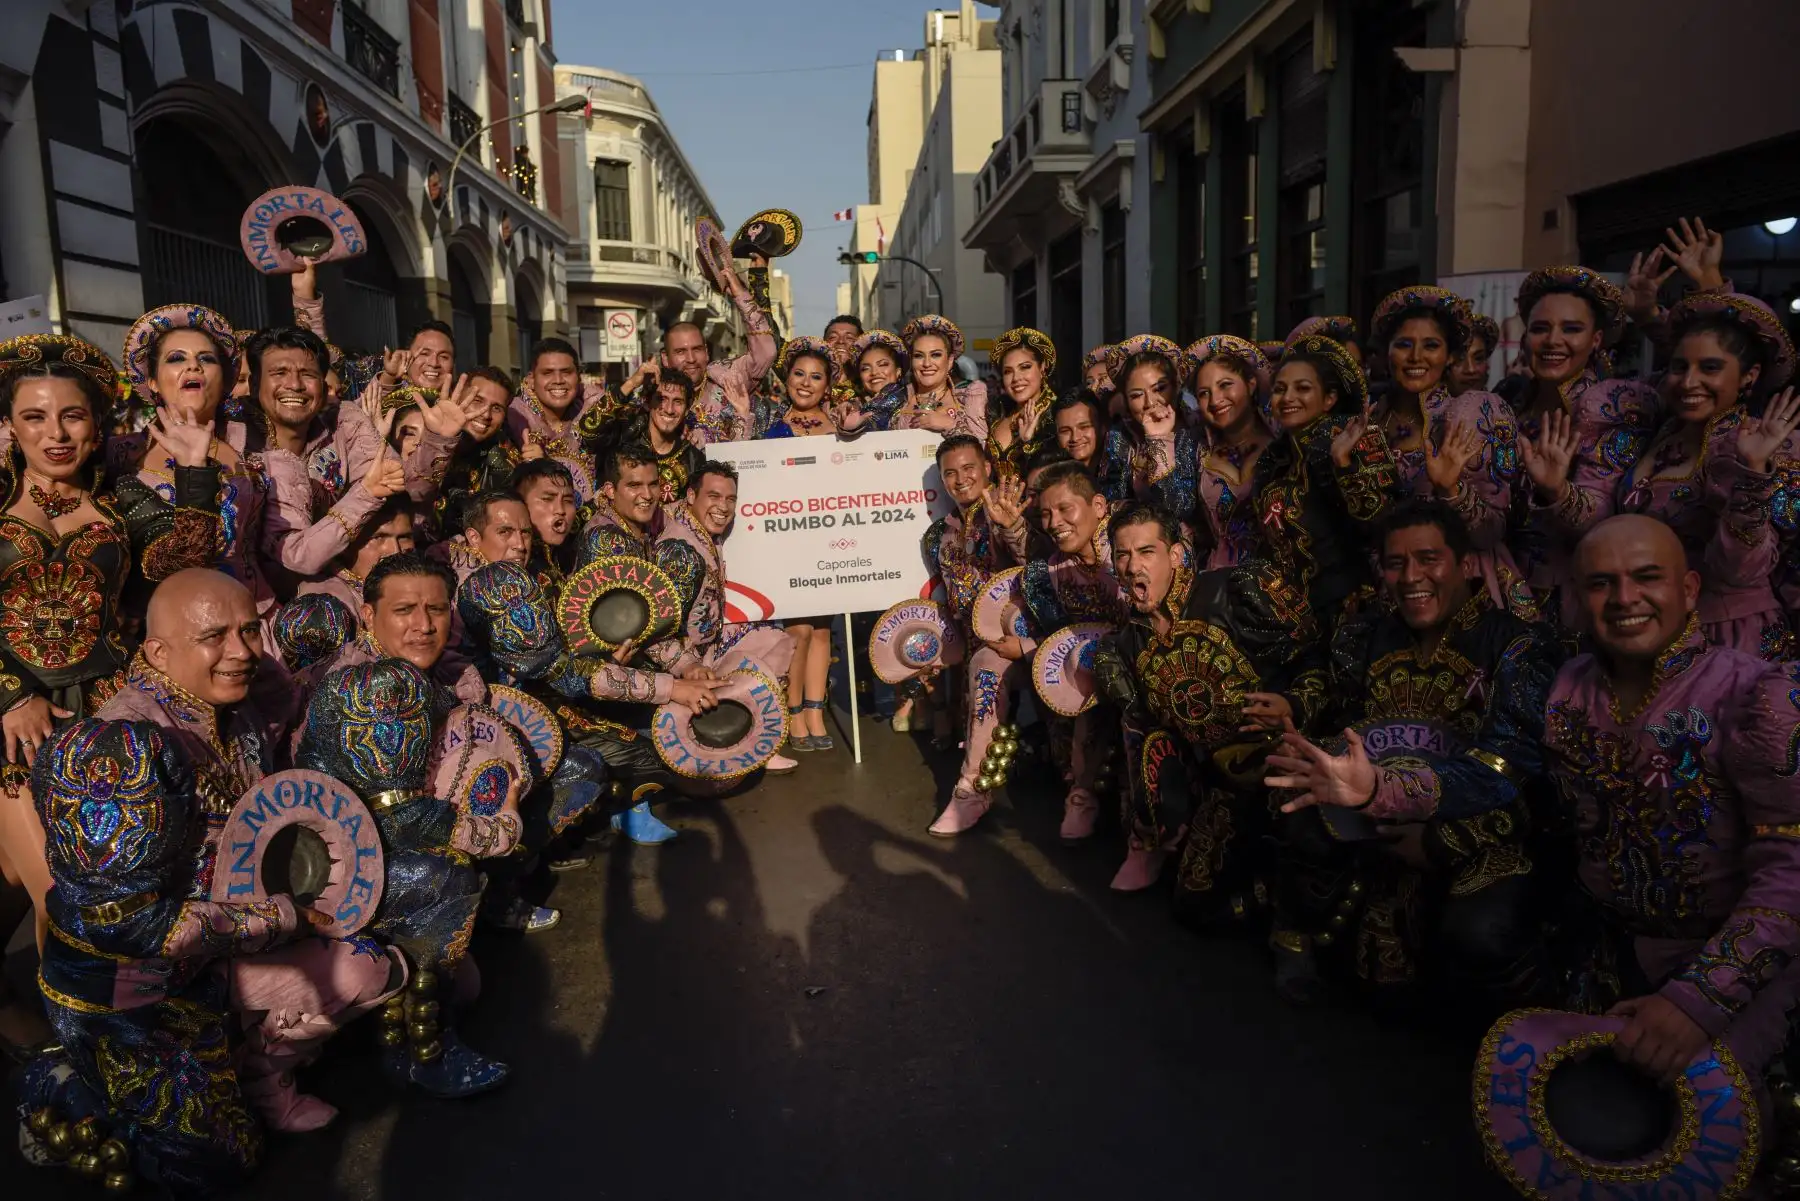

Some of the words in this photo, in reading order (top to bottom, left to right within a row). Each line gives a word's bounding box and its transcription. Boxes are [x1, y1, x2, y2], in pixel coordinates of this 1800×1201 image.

[249, 193, 365, 271] INMORTALES
[885, 451, 909, 460] LIMA
[740, 499, 803, 517] CORSO
[808, 489, 937, 512] BICENTENARIO
[764, 514, 836, 533] RUMBO
[841, 512, 866, 527] AL
[872, 508, 916, 524] 2024
[817, 556, 872, 571] Caporales
[789, 574, 833, 589] Bloque
[836, 569, 902, 585] Inmortales
[565, 564, 674, 648] INMORTALES
[656, 683, 782, 774] INMORTALES
[227, 780, 377, 930] INMORTALES
